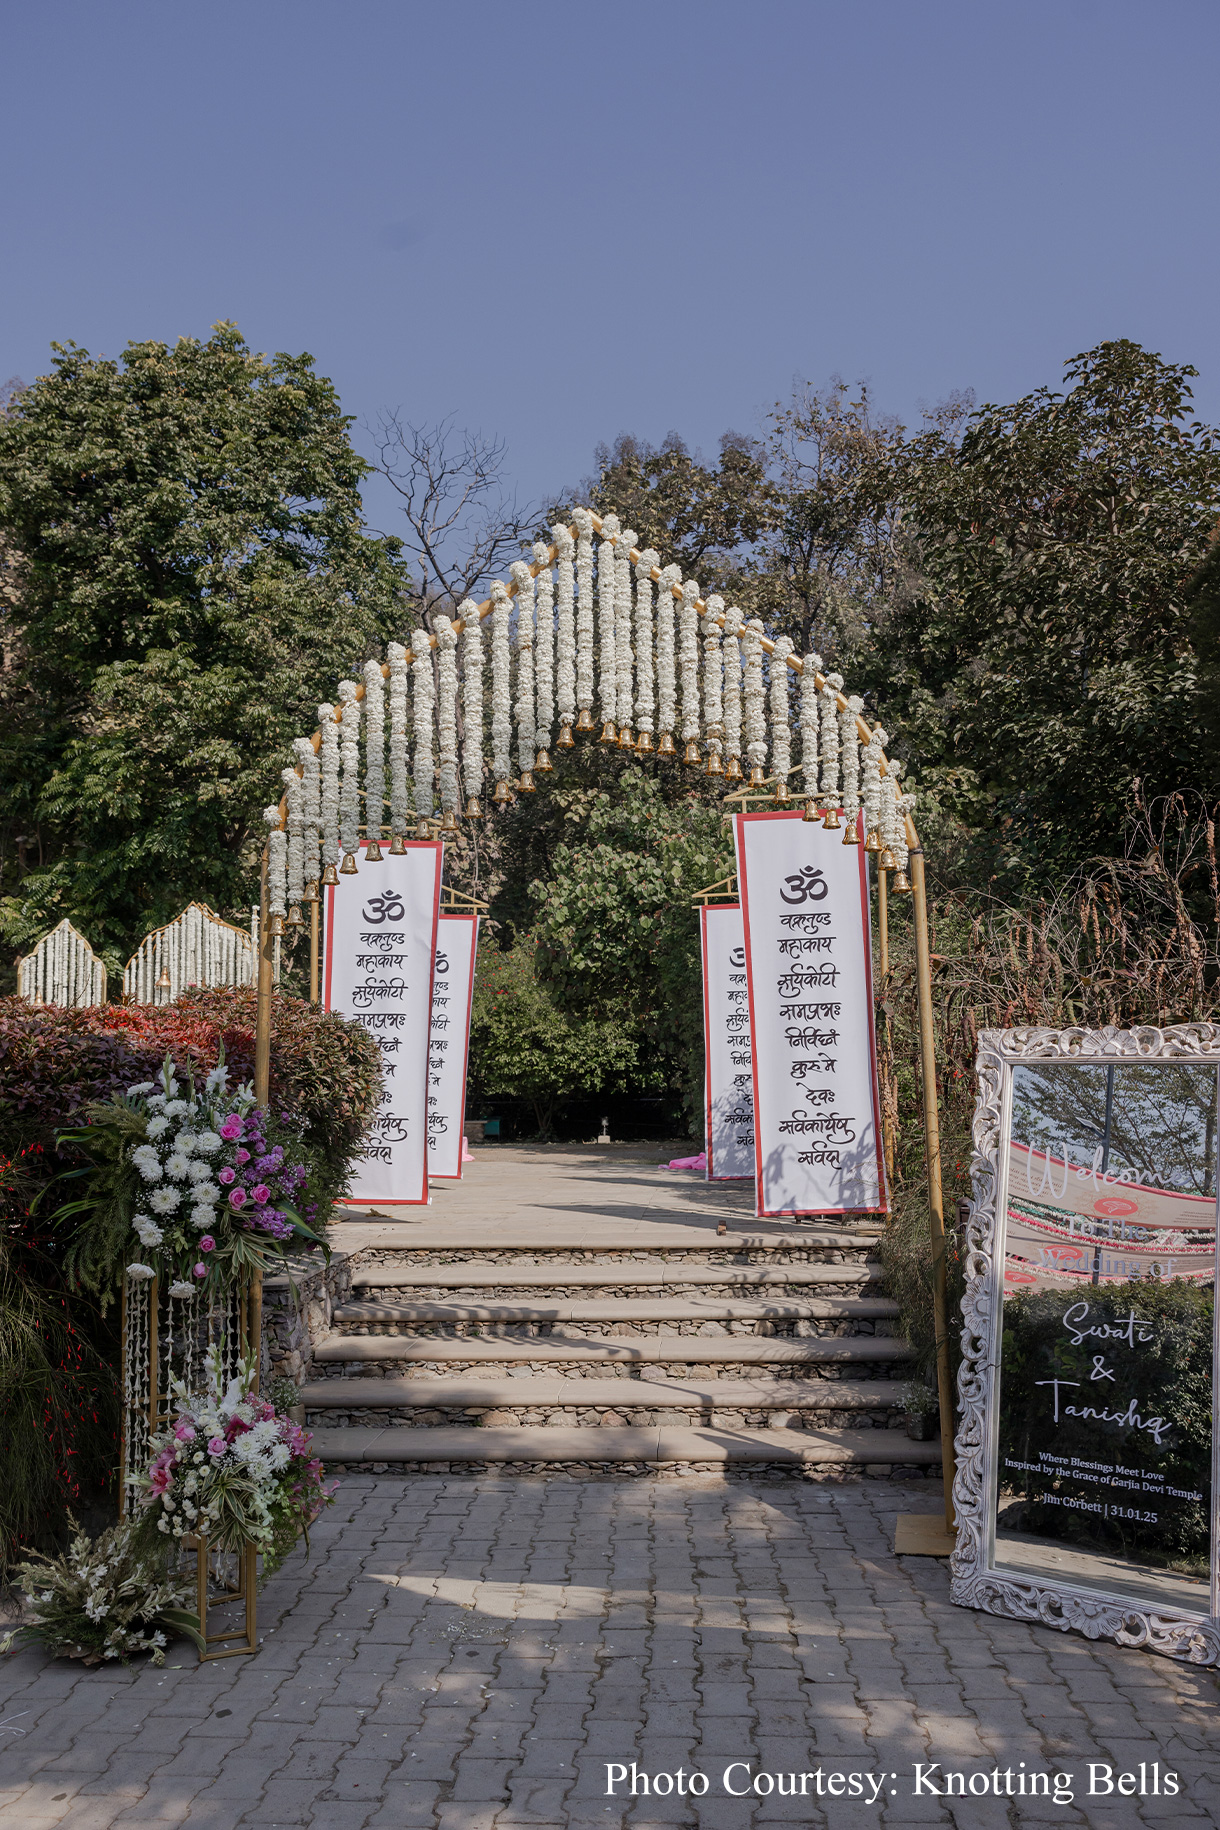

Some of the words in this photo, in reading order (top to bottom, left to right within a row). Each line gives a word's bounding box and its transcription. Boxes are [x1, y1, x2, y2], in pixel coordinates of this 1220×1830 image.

[779, 913, 831, 934] वक्रतुण्ड
[360, 932, 405, 951] वक्रतुण्ड
[777, 937, 836, 959] महाकाय
[356, 955, 408, 973] महाकाय
[818, 1053, 837, 1073] मे
[796, 1082, 835, 1106] देवः
[779, 1110, 855, 1145] सर्वकार्येषु
[798, 1141, 842, 1170] सर्वदा
[1026, 1141, 1191, 1199] Welcome
[1063, 1216, 1096, 1237] To
[1101, 1218, 1148, 1240] The
[1038, 1248, 1141, 1281] Wedding
[1150, 1258, 1177, 1278] of
[1062, 1302, 1153, 1348] Swati
[1090, 1355, 1116, 1381] &
[1035, 1379, 1172, 1444] Tanishq
[1004, 1458, 1041, 1472] Inspired
[1043, 1464, 1054, 1476] by
[1055, 1467, 1071, 1477] the
[1072, 1470, 1099, 1482] Grace
[1100, 1475, 1112, 1485] of
[1112, 1477, 1140, 1491] Garjia
[1142, 1483, 1164, 1494] Devi
[1166, 1486, 1203, 1501] Temple
[1038, 1452, 1069, 1465] Where
[1070, 1457, 1114, 1474] Blessings
[1115, 1465, 1140, 1477] Meet
[1141, 1469, 1165, 1482] Love
[1043, 1493, 1060, 1505] Jim
[1062, 1496, 1102, 1513] Corbett
[1110, 1505, 1158, 1523] 31.01.25
